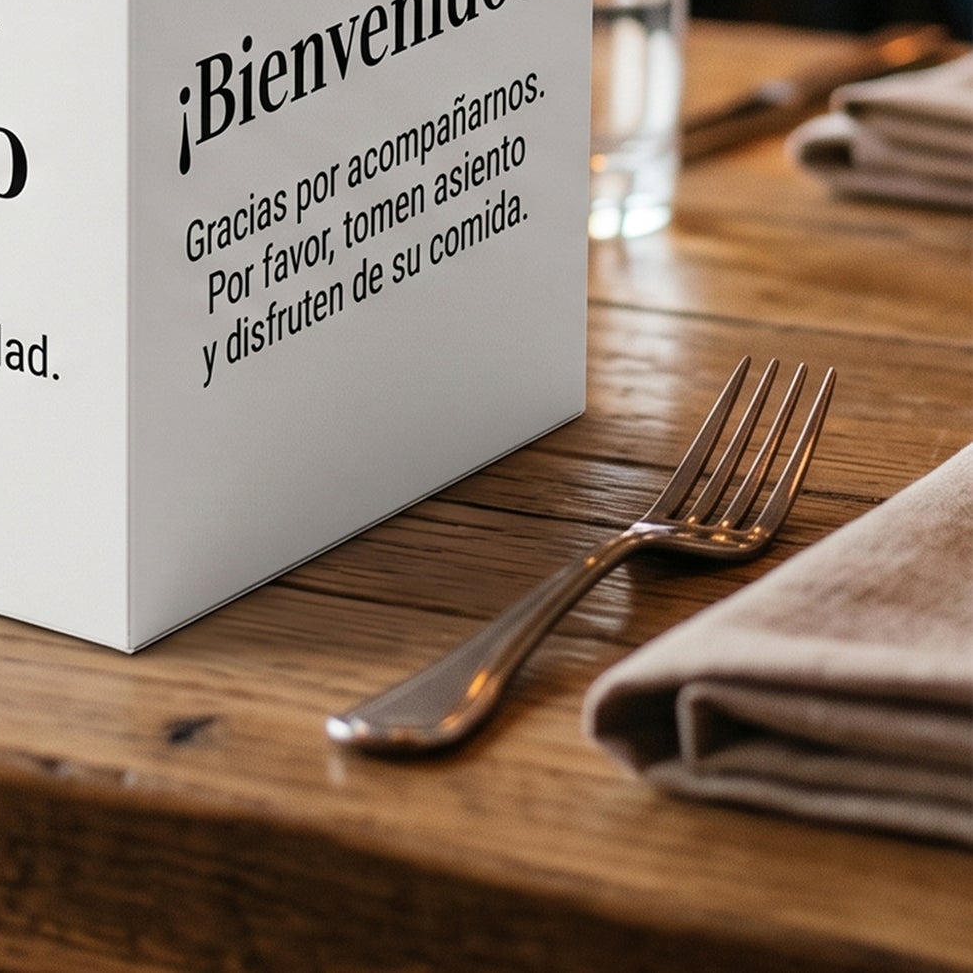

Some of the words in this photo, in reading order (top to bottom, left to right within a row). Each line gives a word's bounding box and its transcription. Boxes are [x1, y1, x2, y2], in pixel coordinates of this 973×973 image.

[186, 189, 287, 263] Gracias
[296, 163, 340, 225] por
[347, 72, 546, 188] acompañarnos.
[208, 263, 255, 315] Por
[262, 227, 335, 289] favor,
[342, 183, 425, 249] tomen
[434, 135, 526, 206] asiento
[202, 340, 218, 389] y
[226, 281, 344, 364] disfruten
[352, 257, 384, 303] de
[392, 243, 421, 284] su
[429, 189, 528, 265] comida.
